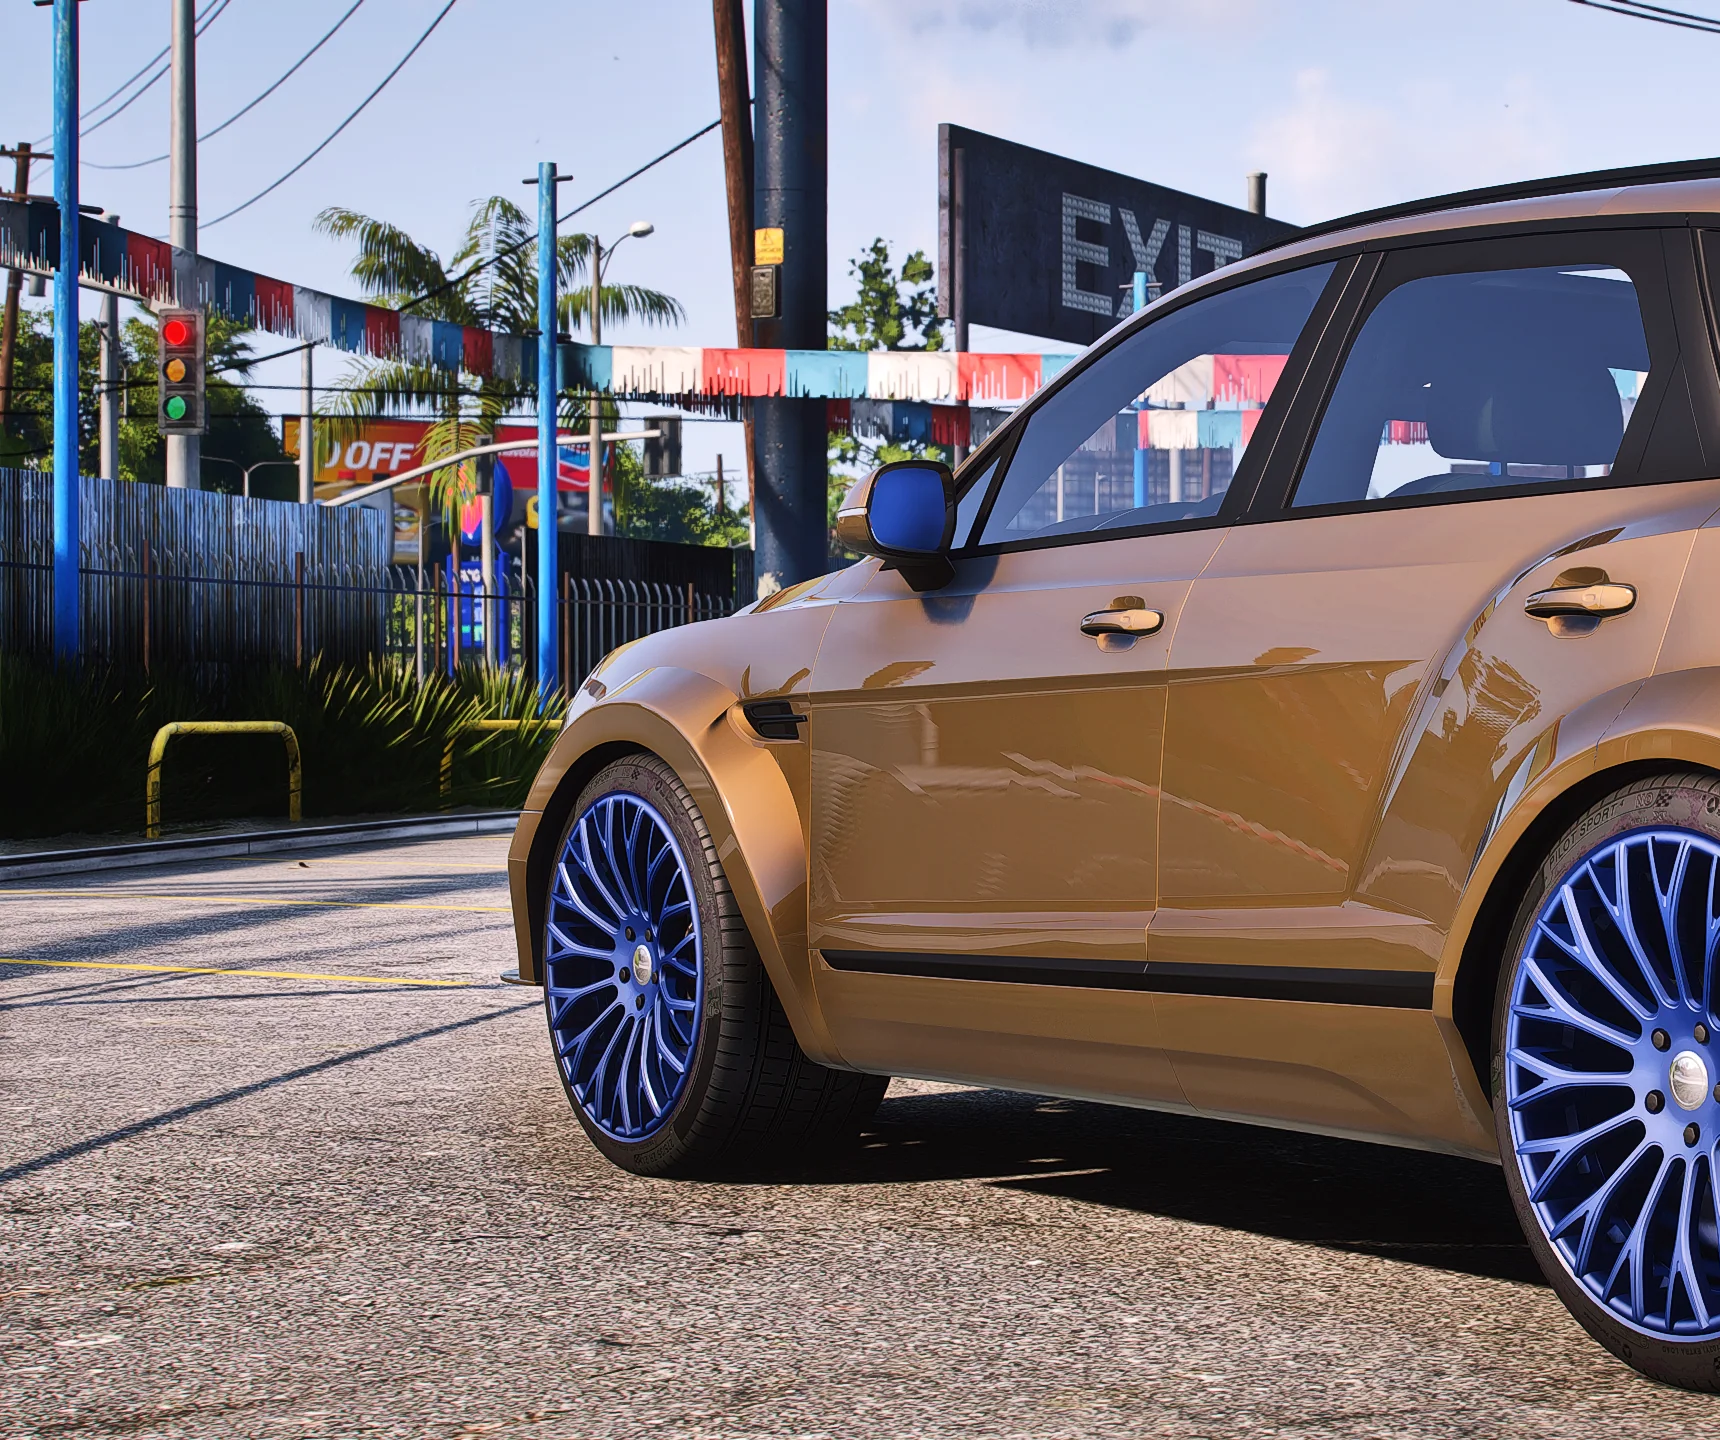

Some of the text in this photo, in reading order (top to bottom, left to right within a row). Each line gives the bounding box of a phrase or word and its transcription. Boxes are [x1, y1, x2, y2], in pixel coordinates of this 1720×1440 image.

[1062, 192, 1242, 318] EXIT
[344, 441, 414, 471] OFF
[1549, 831, 1578, 869] PILOT
[1579, 803, 1619, 836] SPORT
